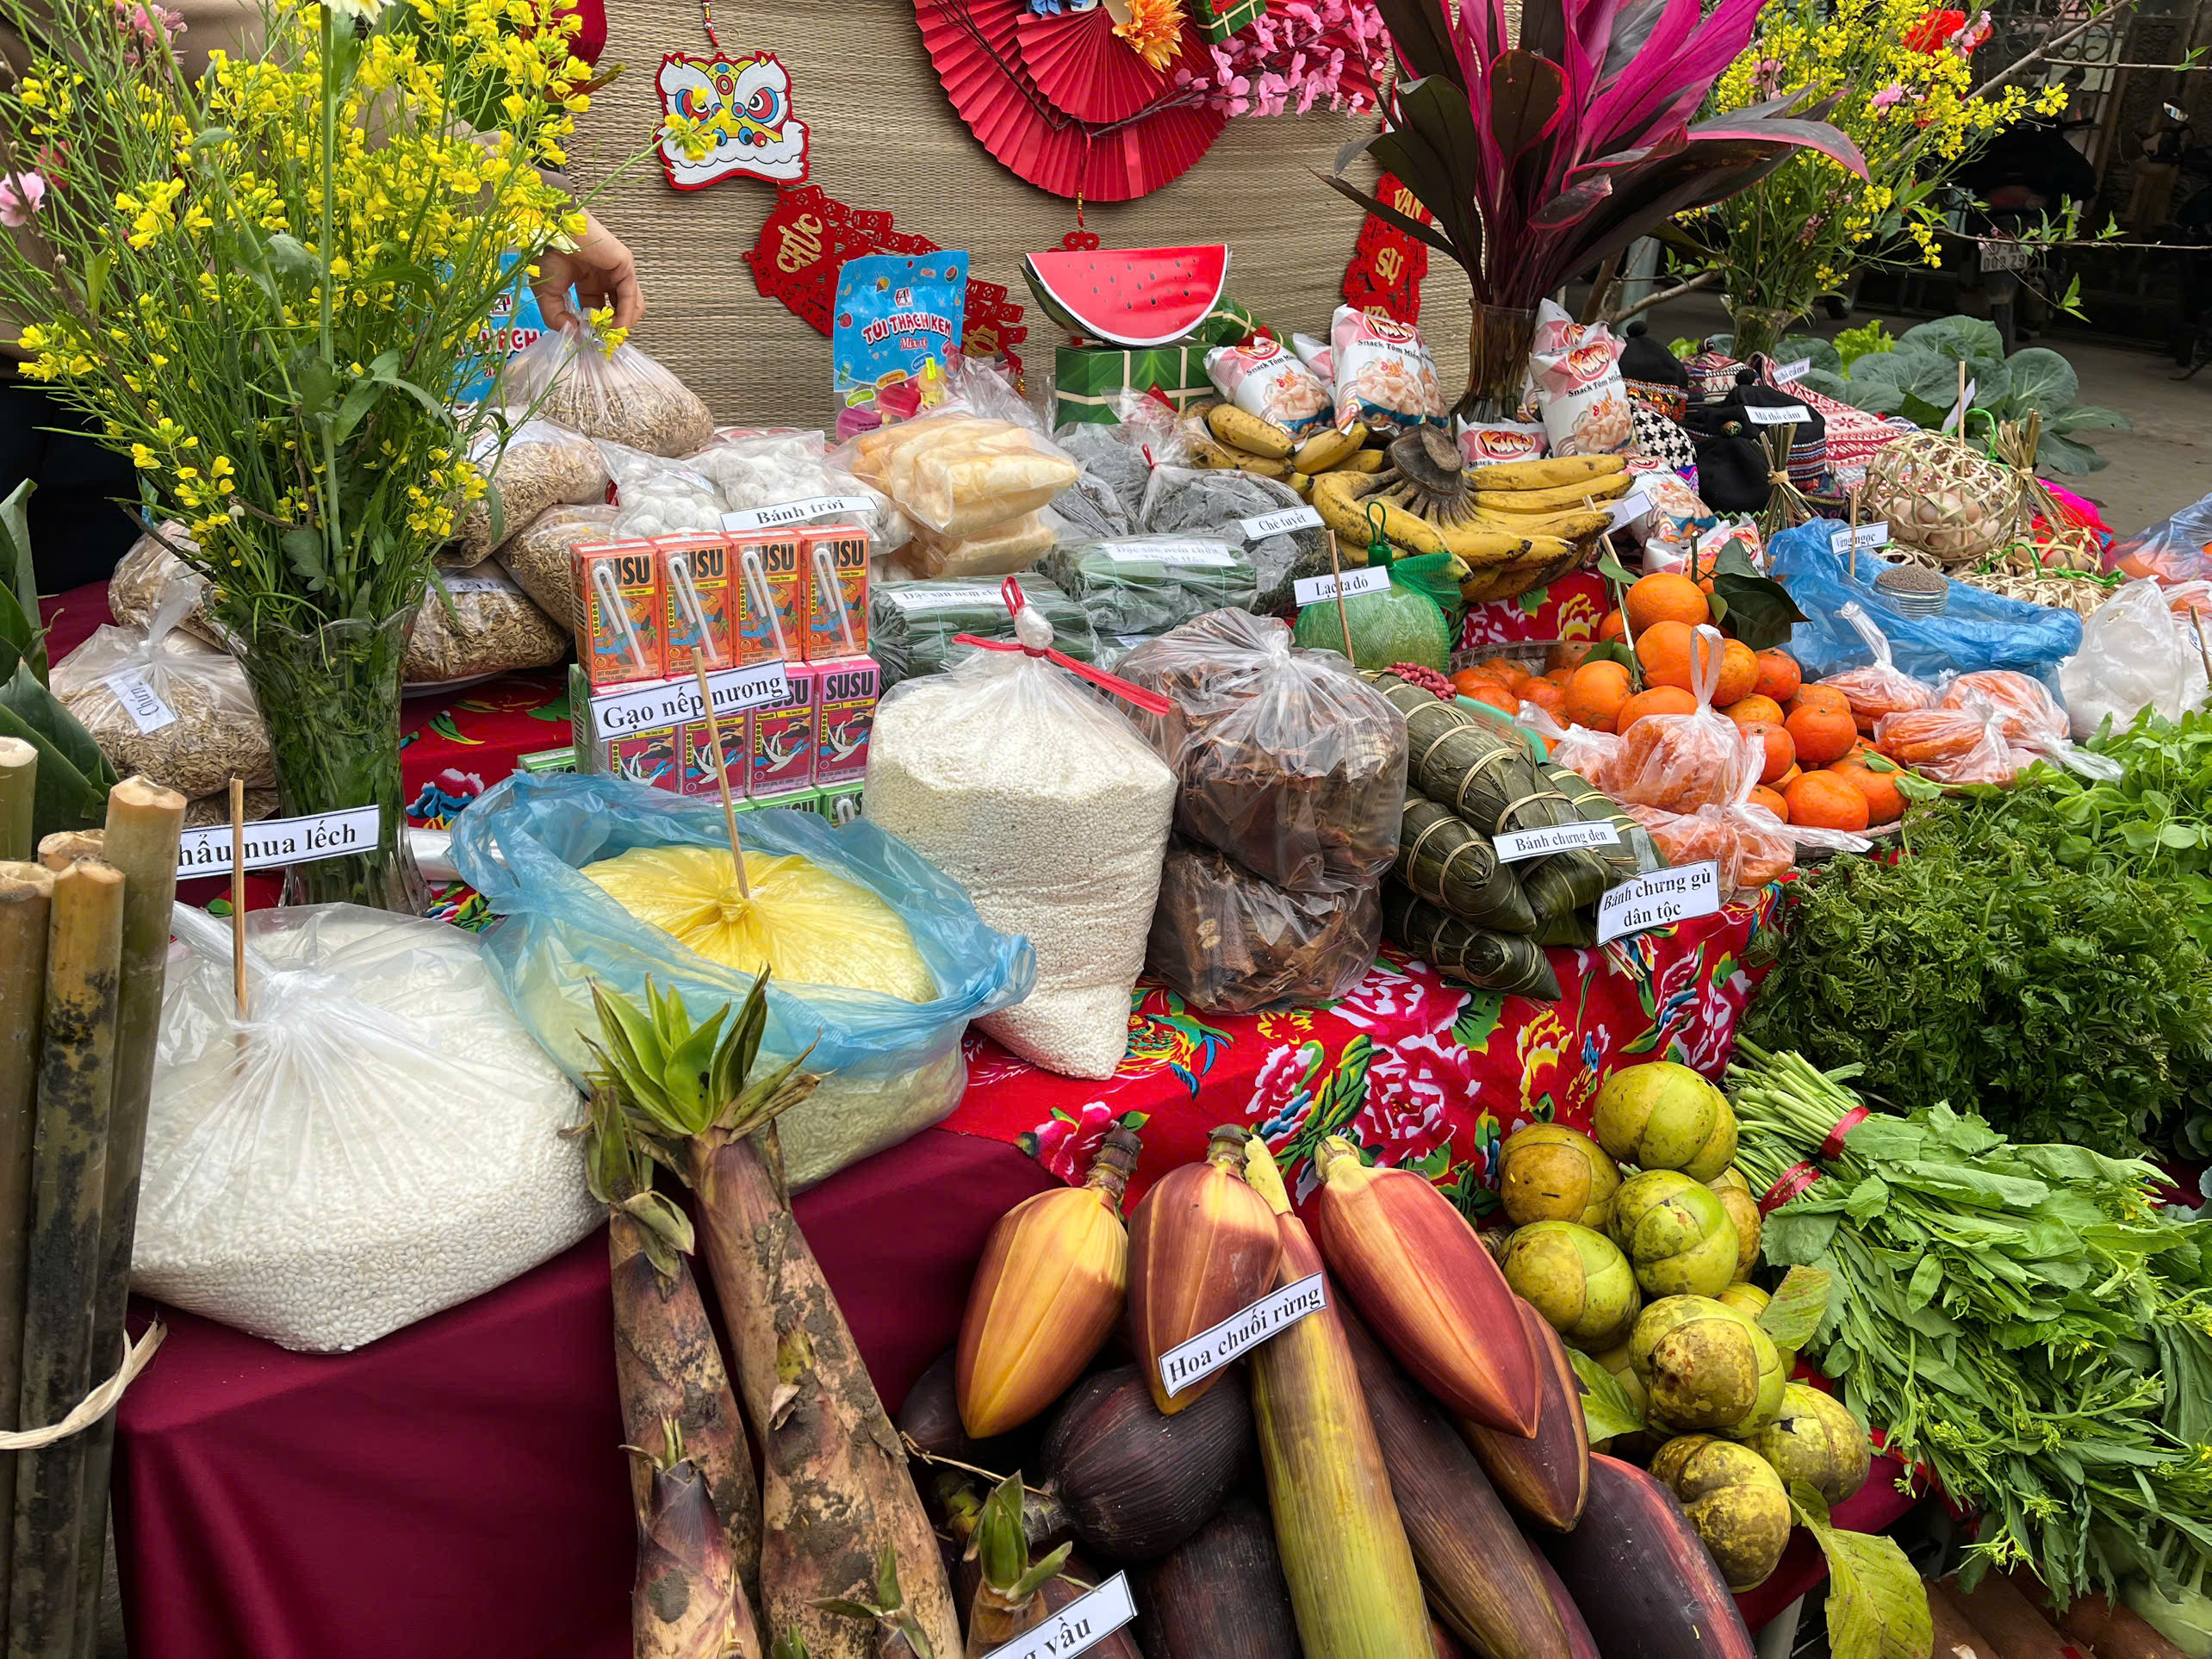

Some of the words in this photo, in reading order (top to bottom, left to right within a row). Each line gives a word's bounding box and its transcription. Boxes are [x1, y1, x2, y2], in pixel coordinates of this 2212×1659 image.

[862, 318, 890, 345] TÚI
[888, 313, 930, 334] THẠCH
[1358, 339, 1384, 349] Snack
[1246, 362, 1269, 376] Snack
[1568, 384, 1593, 398] Snack
[755, 506, 805, 525] Bánh
[1258, 519, 1279, 532] Chè
[1280, 511, 1308, 528] tuyết
[1315, 581, 1337, 599] Lạc
[1353, 574, 1369, 589] đỏ
[826, 671, 874, 701] SUSU
[603, 705, 655, 730] Gạo
[662, 686, 704, 717] nếp
[711, 677, 784, 706] nương
[178, 833, 233, 867] hẩu
[243, 836, 295, 859] nua
[305, 820, 357, 850] lếch
[1515, 836, 1550, 852] Bánh
[1552, 831, 1588, 848] chưng
[1603, 889, 1632, 912] Bánh
[1635, 876, 1686, 898] chưng
[1691, 868, 1711, 891] gù
[1623, 906, 1652, 928] dân
[1656, 901, 1681, 923] tộc
[1168, 1349, 1212, 1385] Hoa
[1217, 1308, 1269, 1357] chuối
[1273, 1287, 1320, 1324] rừng
[1043, 1616, 1092, 1656] vầu
